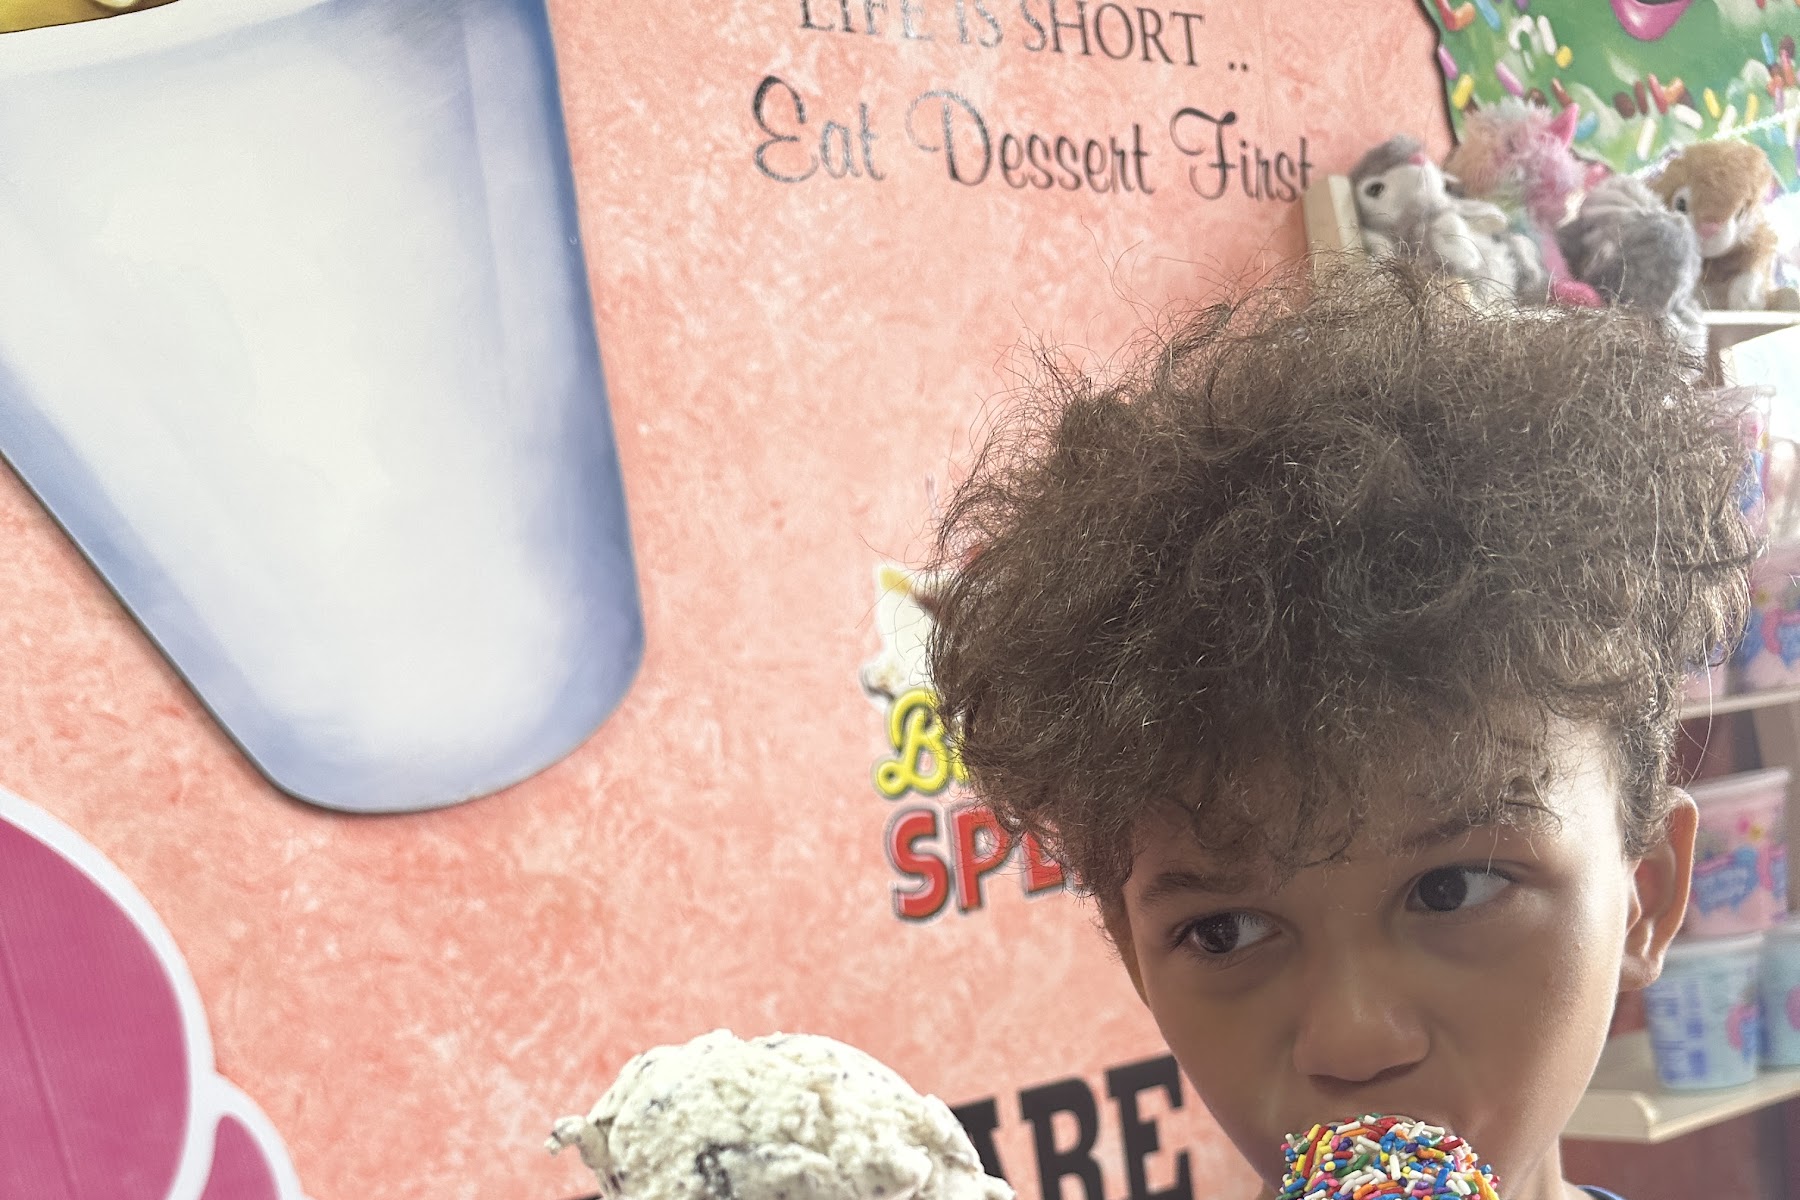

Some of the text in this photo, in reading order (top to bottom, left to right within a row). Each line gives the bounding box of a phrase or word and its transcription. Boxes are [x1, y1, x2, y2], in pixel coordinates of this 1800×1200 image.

[955, 0, 1003, 48] IS
[1020, 0, 1205, 67] SHORT
[752, 74, 1315, 202] Eat Dessert First
